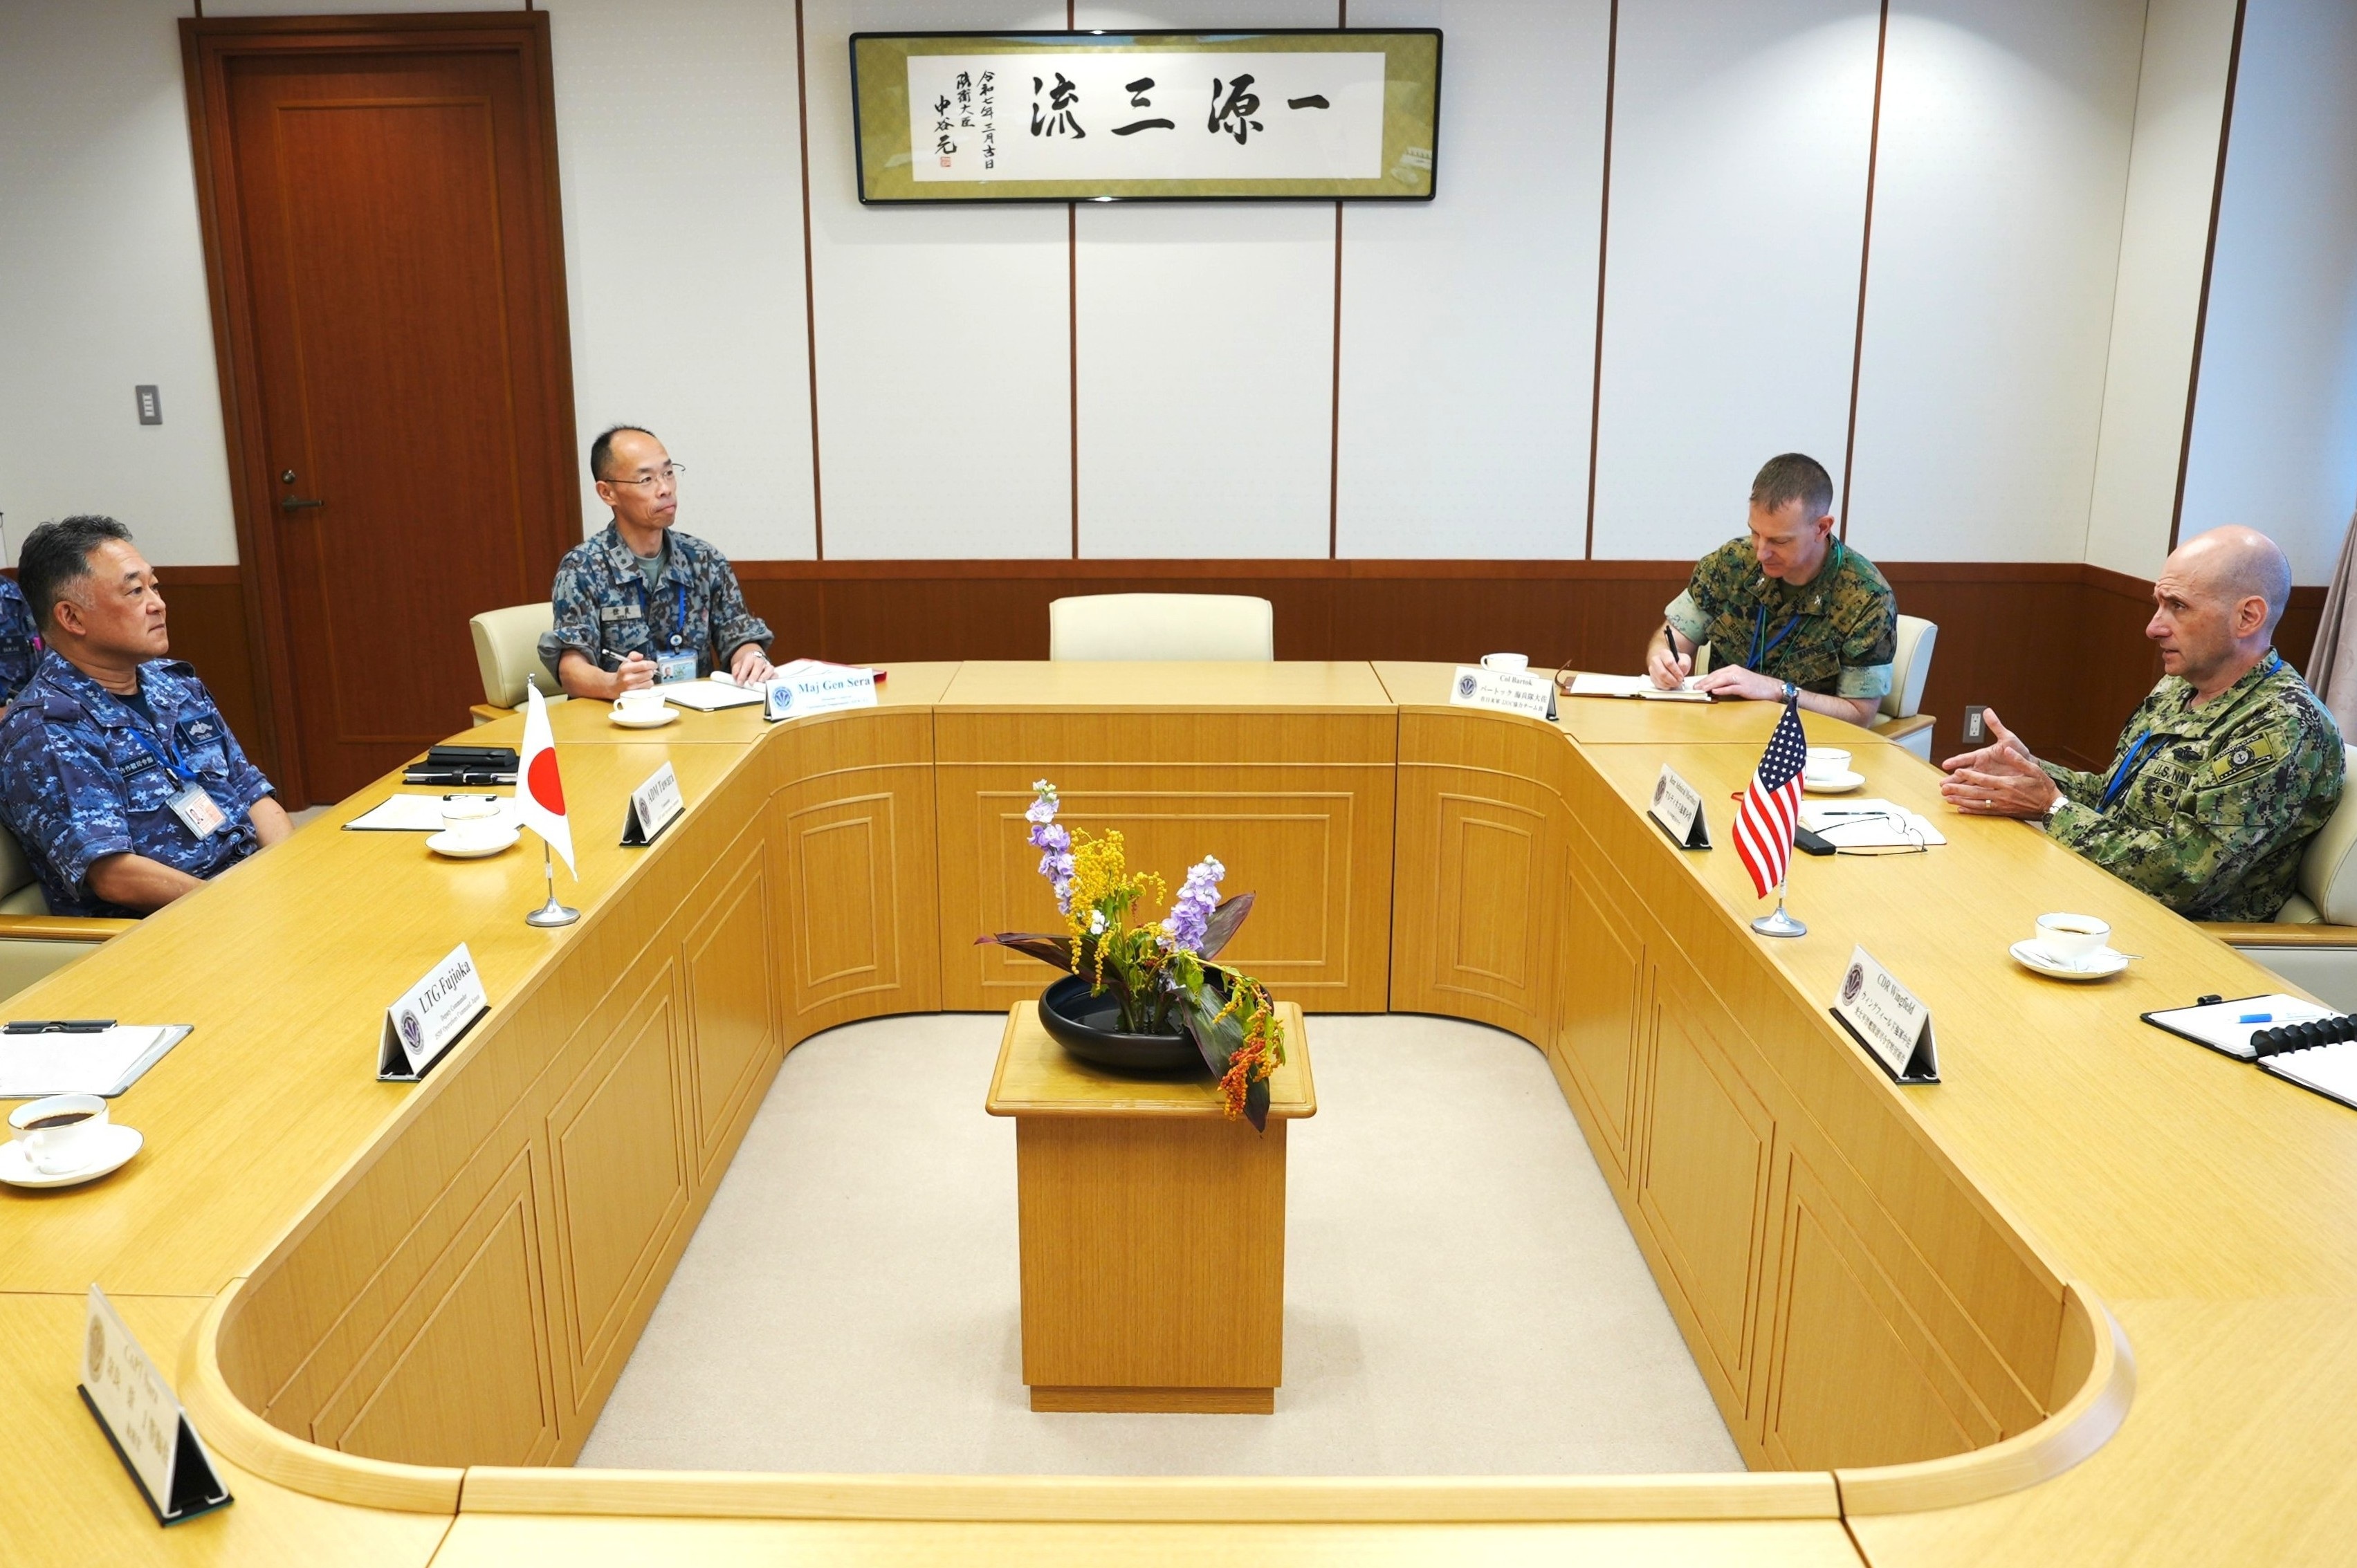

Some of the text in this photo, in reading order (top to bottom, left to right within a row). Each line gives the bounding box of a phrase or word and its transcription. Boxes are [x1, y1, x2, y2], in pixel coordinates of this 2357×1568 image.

[798, 677, 870, 694] Maj Gen Sera
[1512, 676, 1533, 686] Bartok
[2154, 764, 2192, 788] U.S. NAV
[648, 784, 660, 804] ADM
[419, 961, 471, 1015] LTG Fujioka
[1877, 973, 1891, 993] CDR
[1891, 984, 1916, 1015] Wingfield
